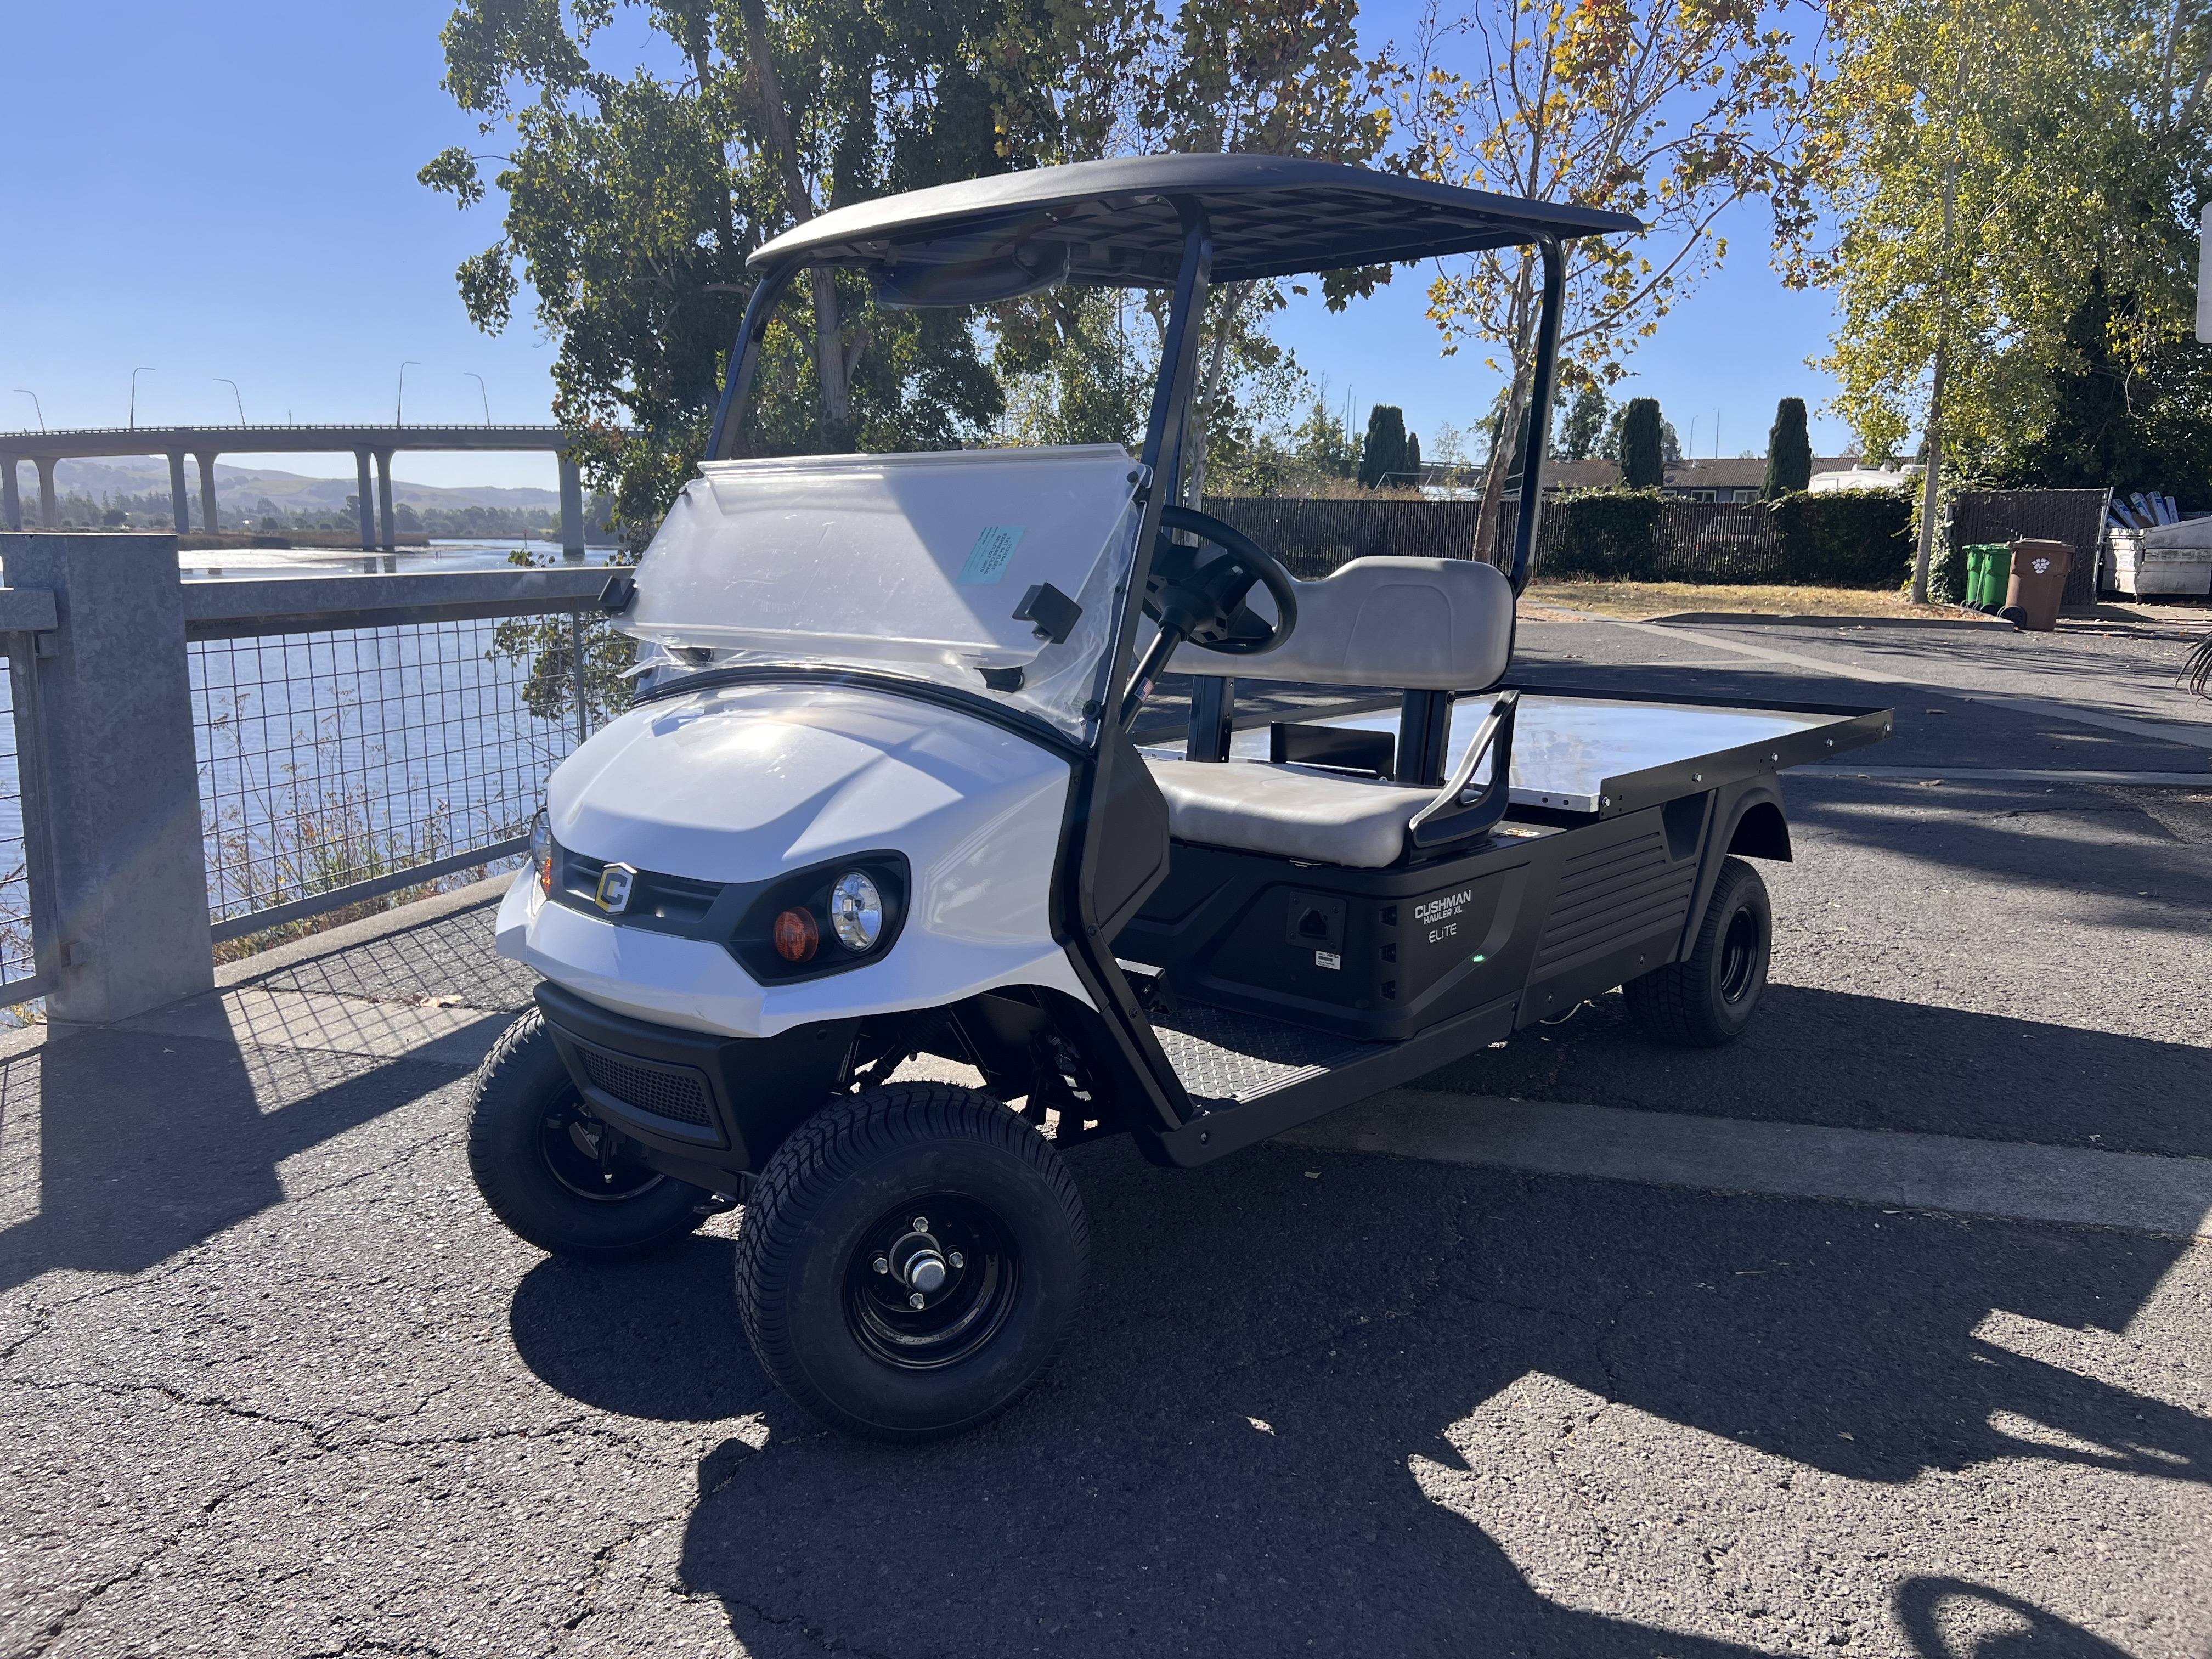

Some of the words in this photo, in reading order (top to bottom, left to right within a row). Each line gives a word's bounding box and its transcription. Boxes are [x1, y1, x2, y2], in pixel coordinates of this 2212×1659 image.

[992, 533, 1007, 556] EXPRESS
[984, 557, 995, 574] CLEAR
[991, 554, 1002, 570] FLEET
[600, 873, 628, 905] C
[1415, 889, 1471, 919] CUSHMAN
[1424, 908, 1452, 925] HAULER
[1454, 905, 1463, 915] XL
